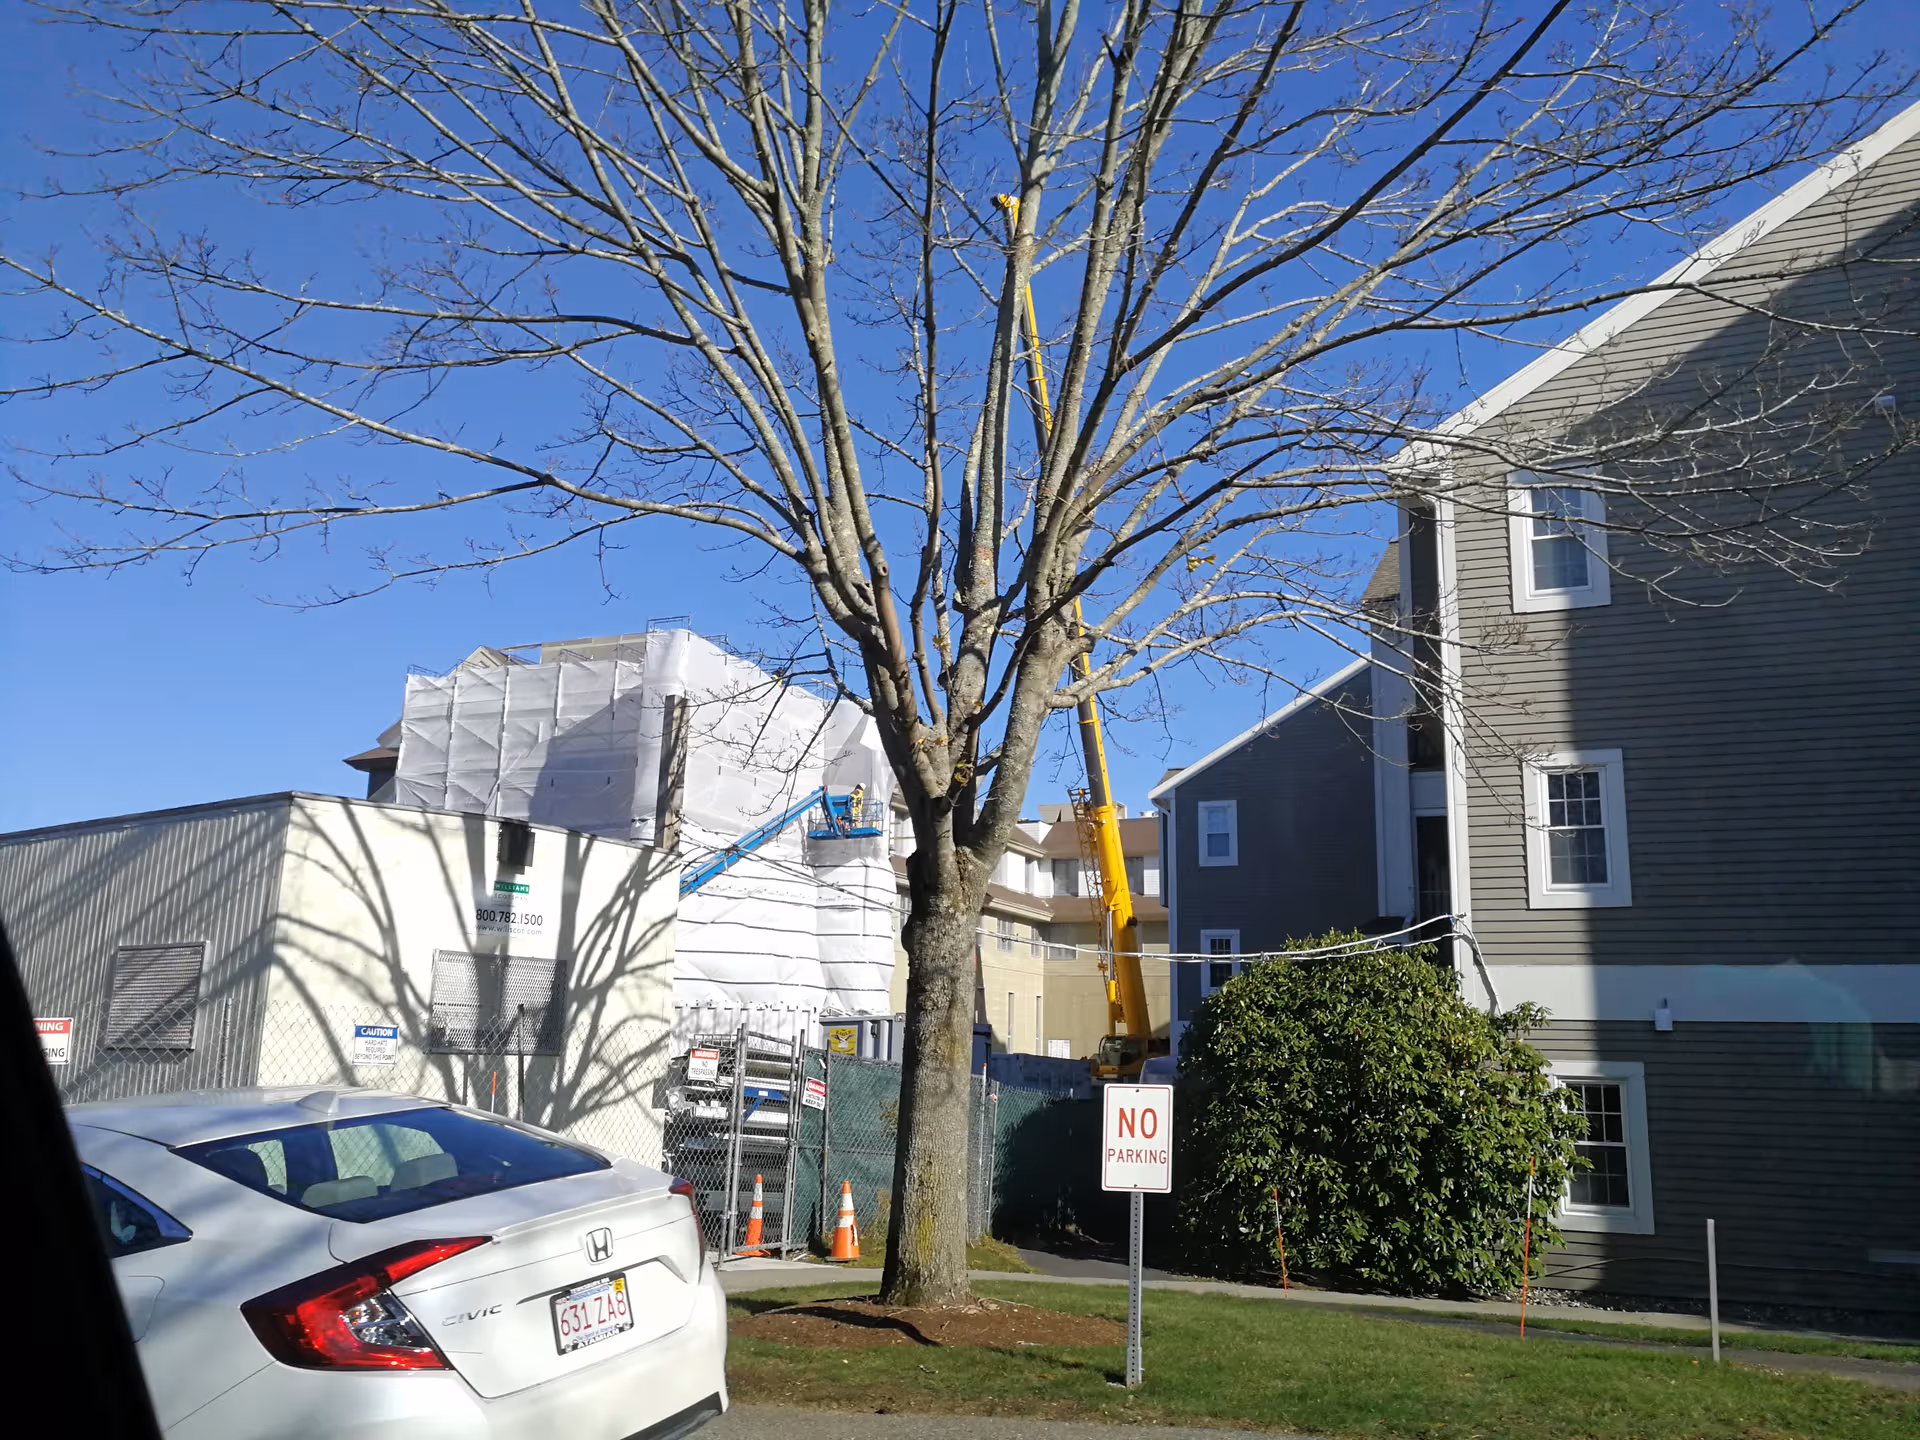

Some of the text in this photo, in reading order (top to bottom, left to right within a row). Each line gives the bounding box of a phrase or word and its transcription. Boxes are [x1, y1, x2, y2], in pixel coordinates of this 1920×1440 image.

[496, 883, 529, 893] WILLIAMS
[476, 908, 543, 926] 800.782.1500
[361, 1027, 393, 1036] CAUTION
[1118, 1107, 1157, 1139] NO
[1107, 1148, 1168, 1165] PARKING
[442, 1304, 502, 1327] CIVIC
[560, 1301, 592, 1336] 631
[594, 1290, 627, 1325] ZA8
[577, 1329, 620, 1348] ATAMIAN
